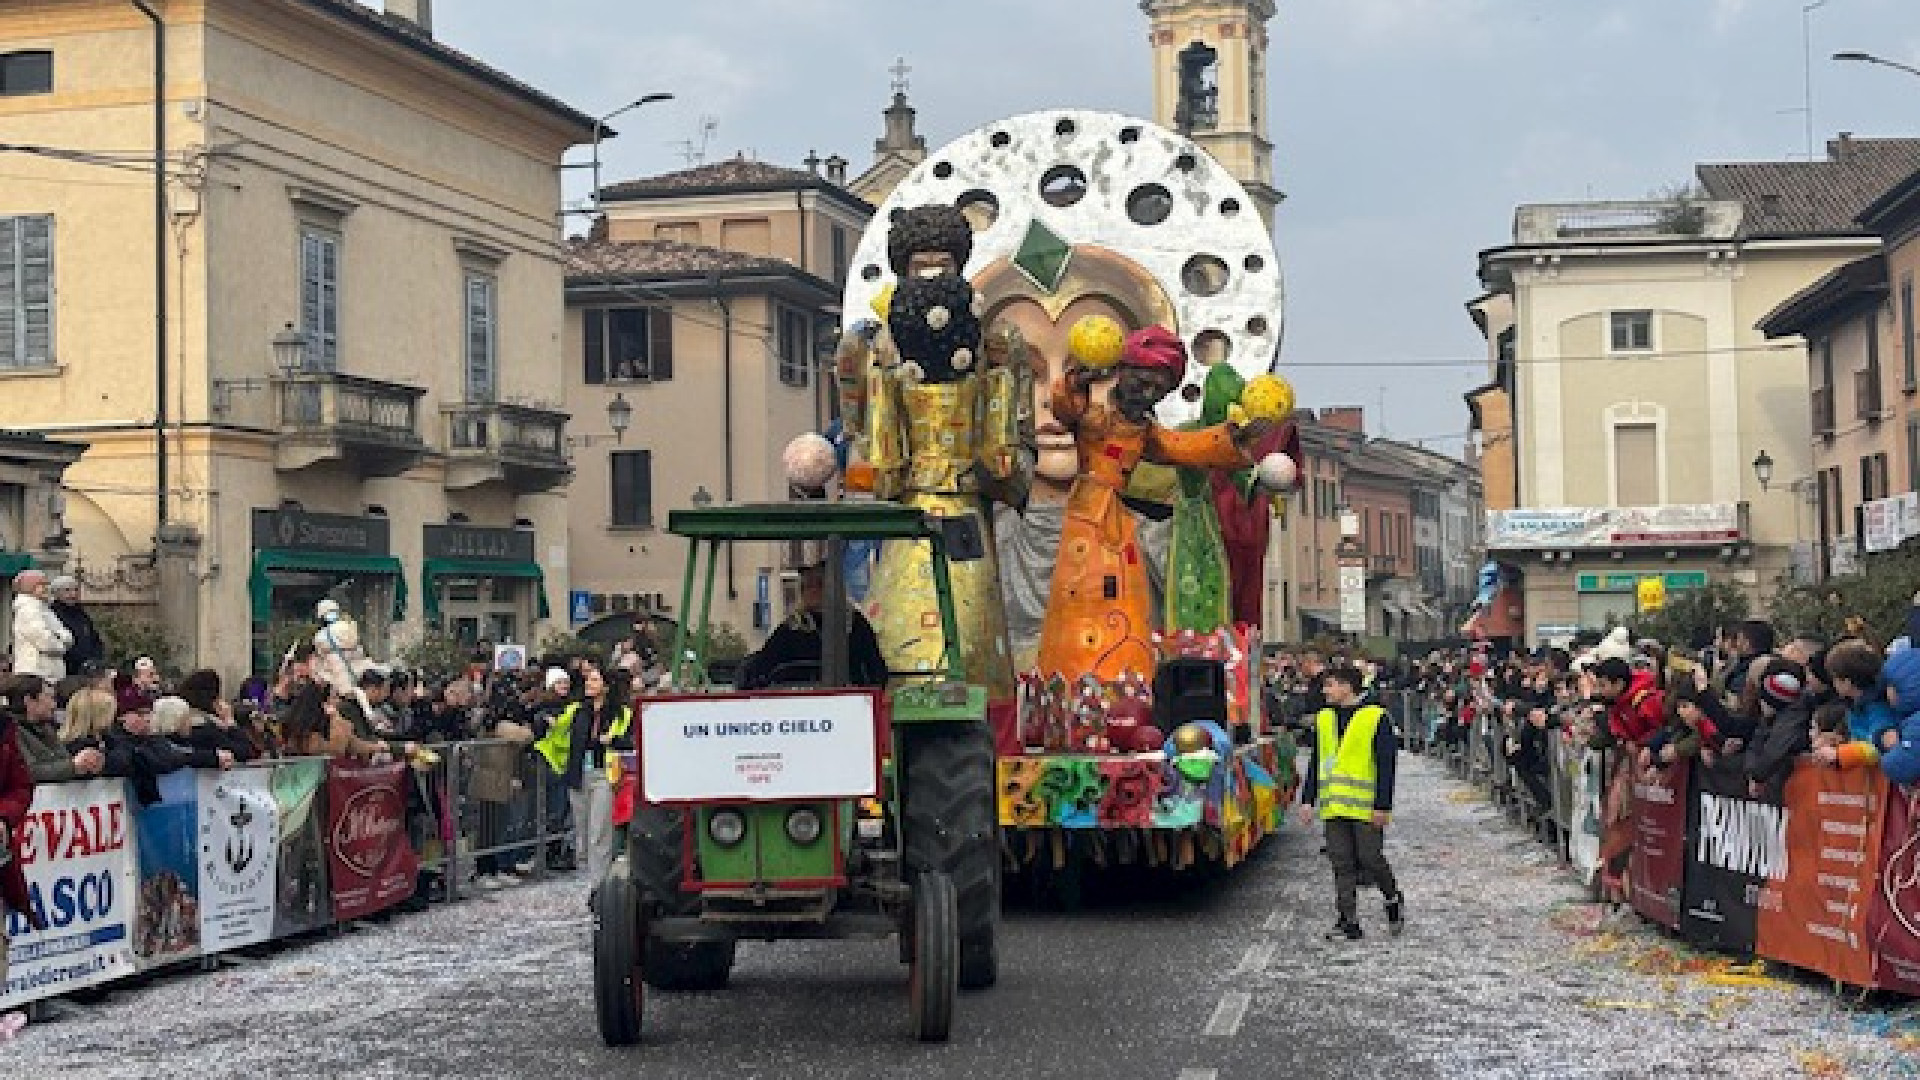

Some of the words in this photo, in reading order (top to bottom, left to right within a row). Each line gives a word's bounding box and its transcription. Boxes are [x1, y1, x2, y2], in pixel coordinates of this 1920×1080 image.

[683, 722, 709, 738] UN
[716, 721, 772, 736] UNICO
[779, 719, 834, 734] CIELO
[15, 801, 125, 867] EVALE
[1697, 792, 1790, 881] PHANTOM
[8, 868, 114, 937] ASCO
